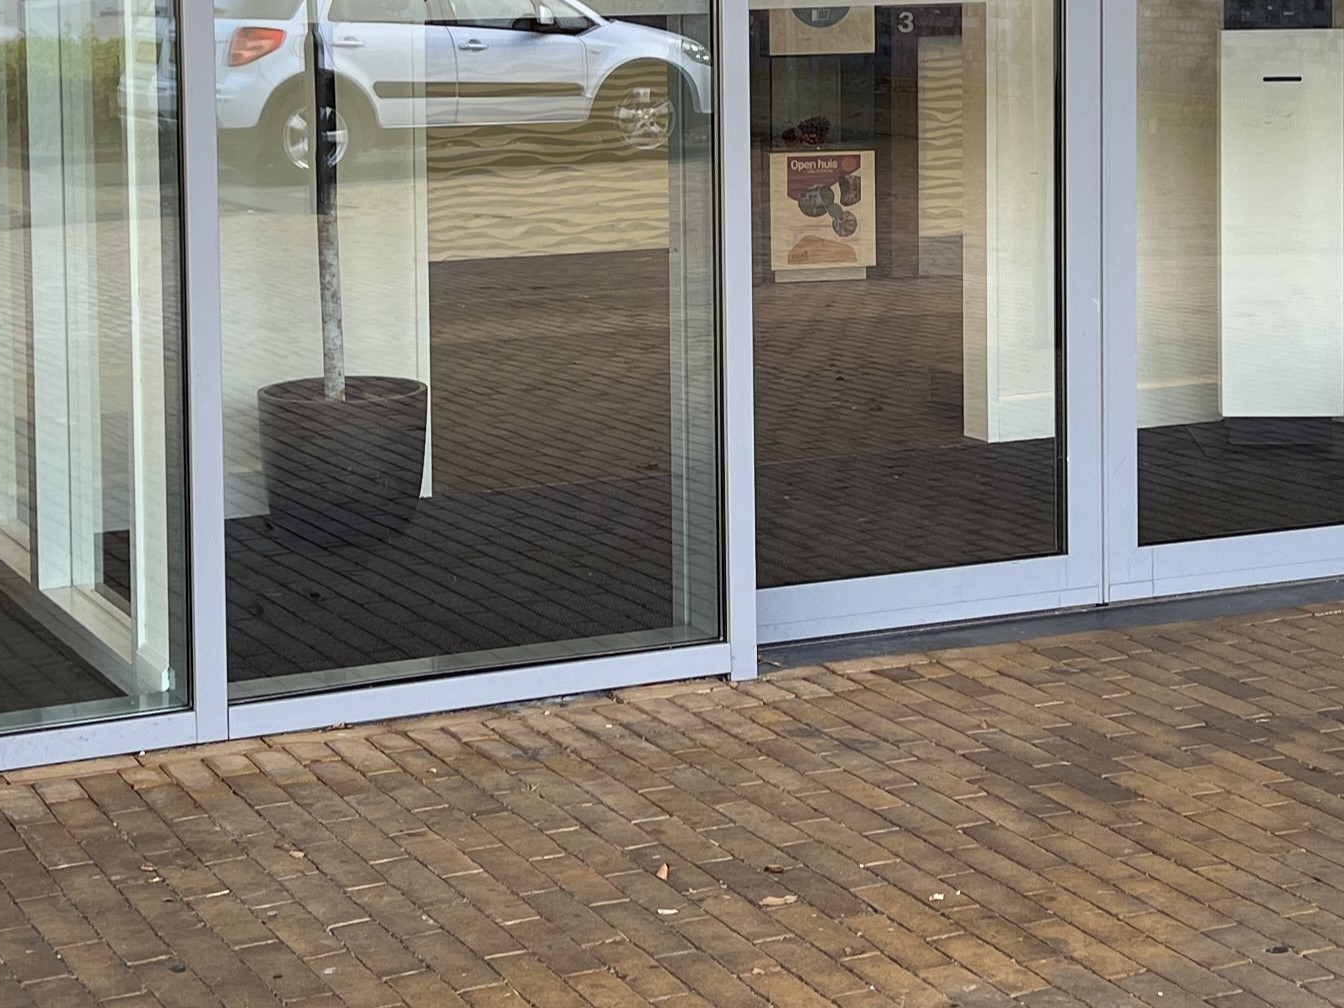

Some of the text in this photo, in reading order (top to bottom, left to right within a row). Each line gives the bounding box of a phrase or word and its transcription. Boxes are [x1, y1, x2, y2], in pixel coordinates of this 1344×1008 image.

[898, 11, 914, 33] 3
[790, 159, 816, 172] Open
[817, 158, 838, 169] huis
